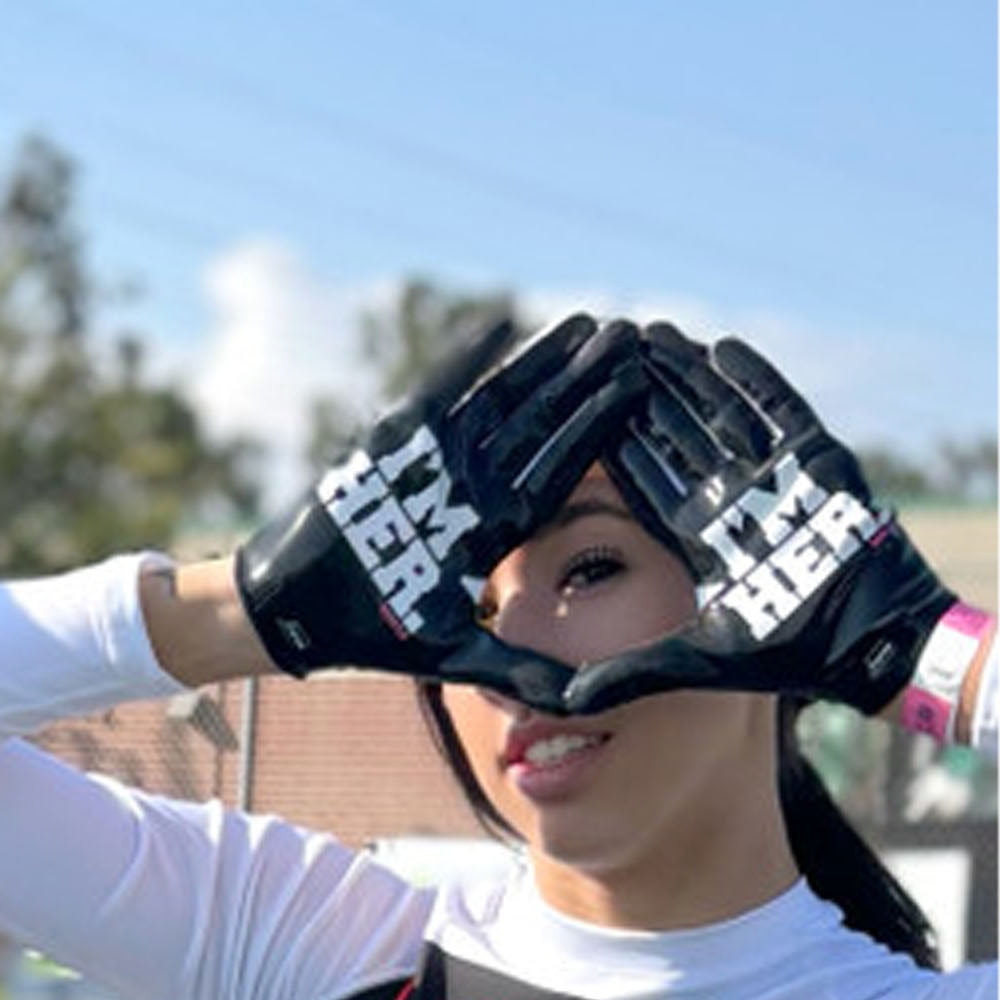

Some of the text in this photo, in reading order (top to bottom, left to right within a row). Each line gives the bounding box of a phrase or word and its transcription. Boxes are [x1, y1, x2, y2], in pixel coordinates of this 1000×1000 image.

[317, 449, 441, 635] HER.
[377, 424, 481, 563] I'M
[700, 452, 829, 580] I'M
